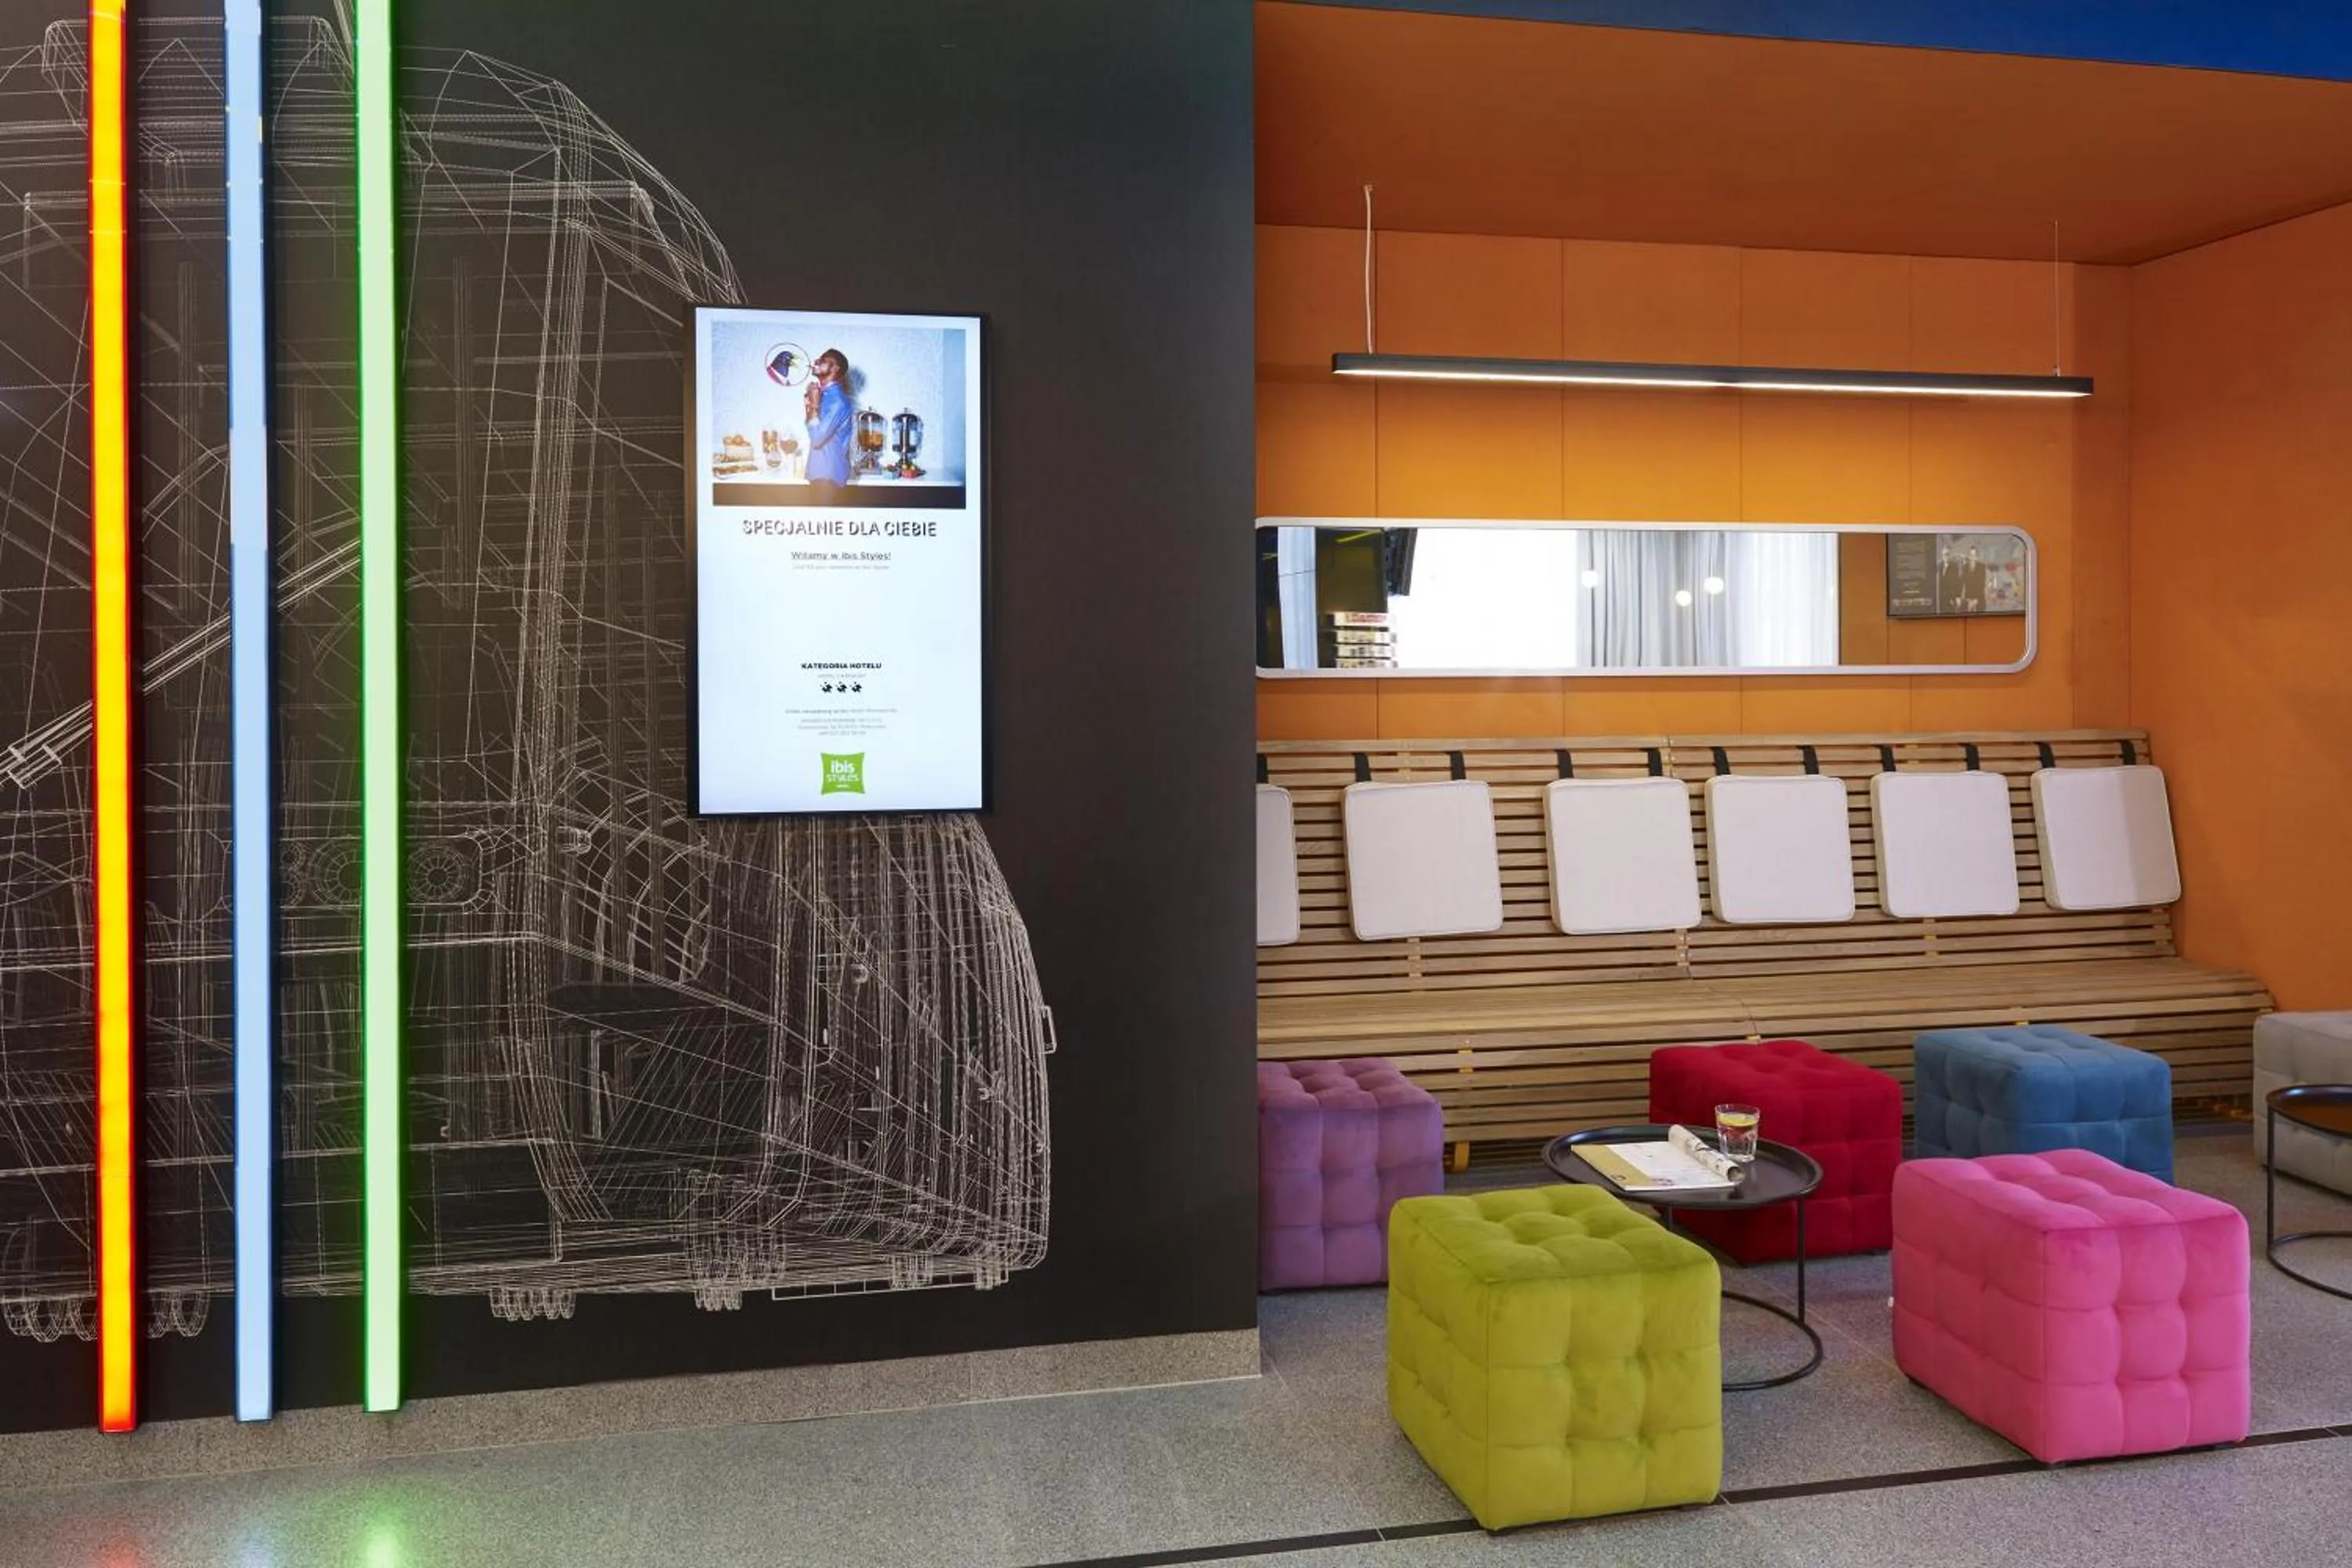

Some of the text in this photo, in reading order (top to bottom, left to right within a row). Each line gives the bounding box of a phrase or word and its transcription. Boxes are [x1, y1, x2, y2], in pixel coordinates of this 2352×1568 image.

[742, 520, 937, 538] SPECJALNIE DLA CIEBIE
[791, 551, 827, 561] Witamy
[831, 759, 855, 773] ibis
